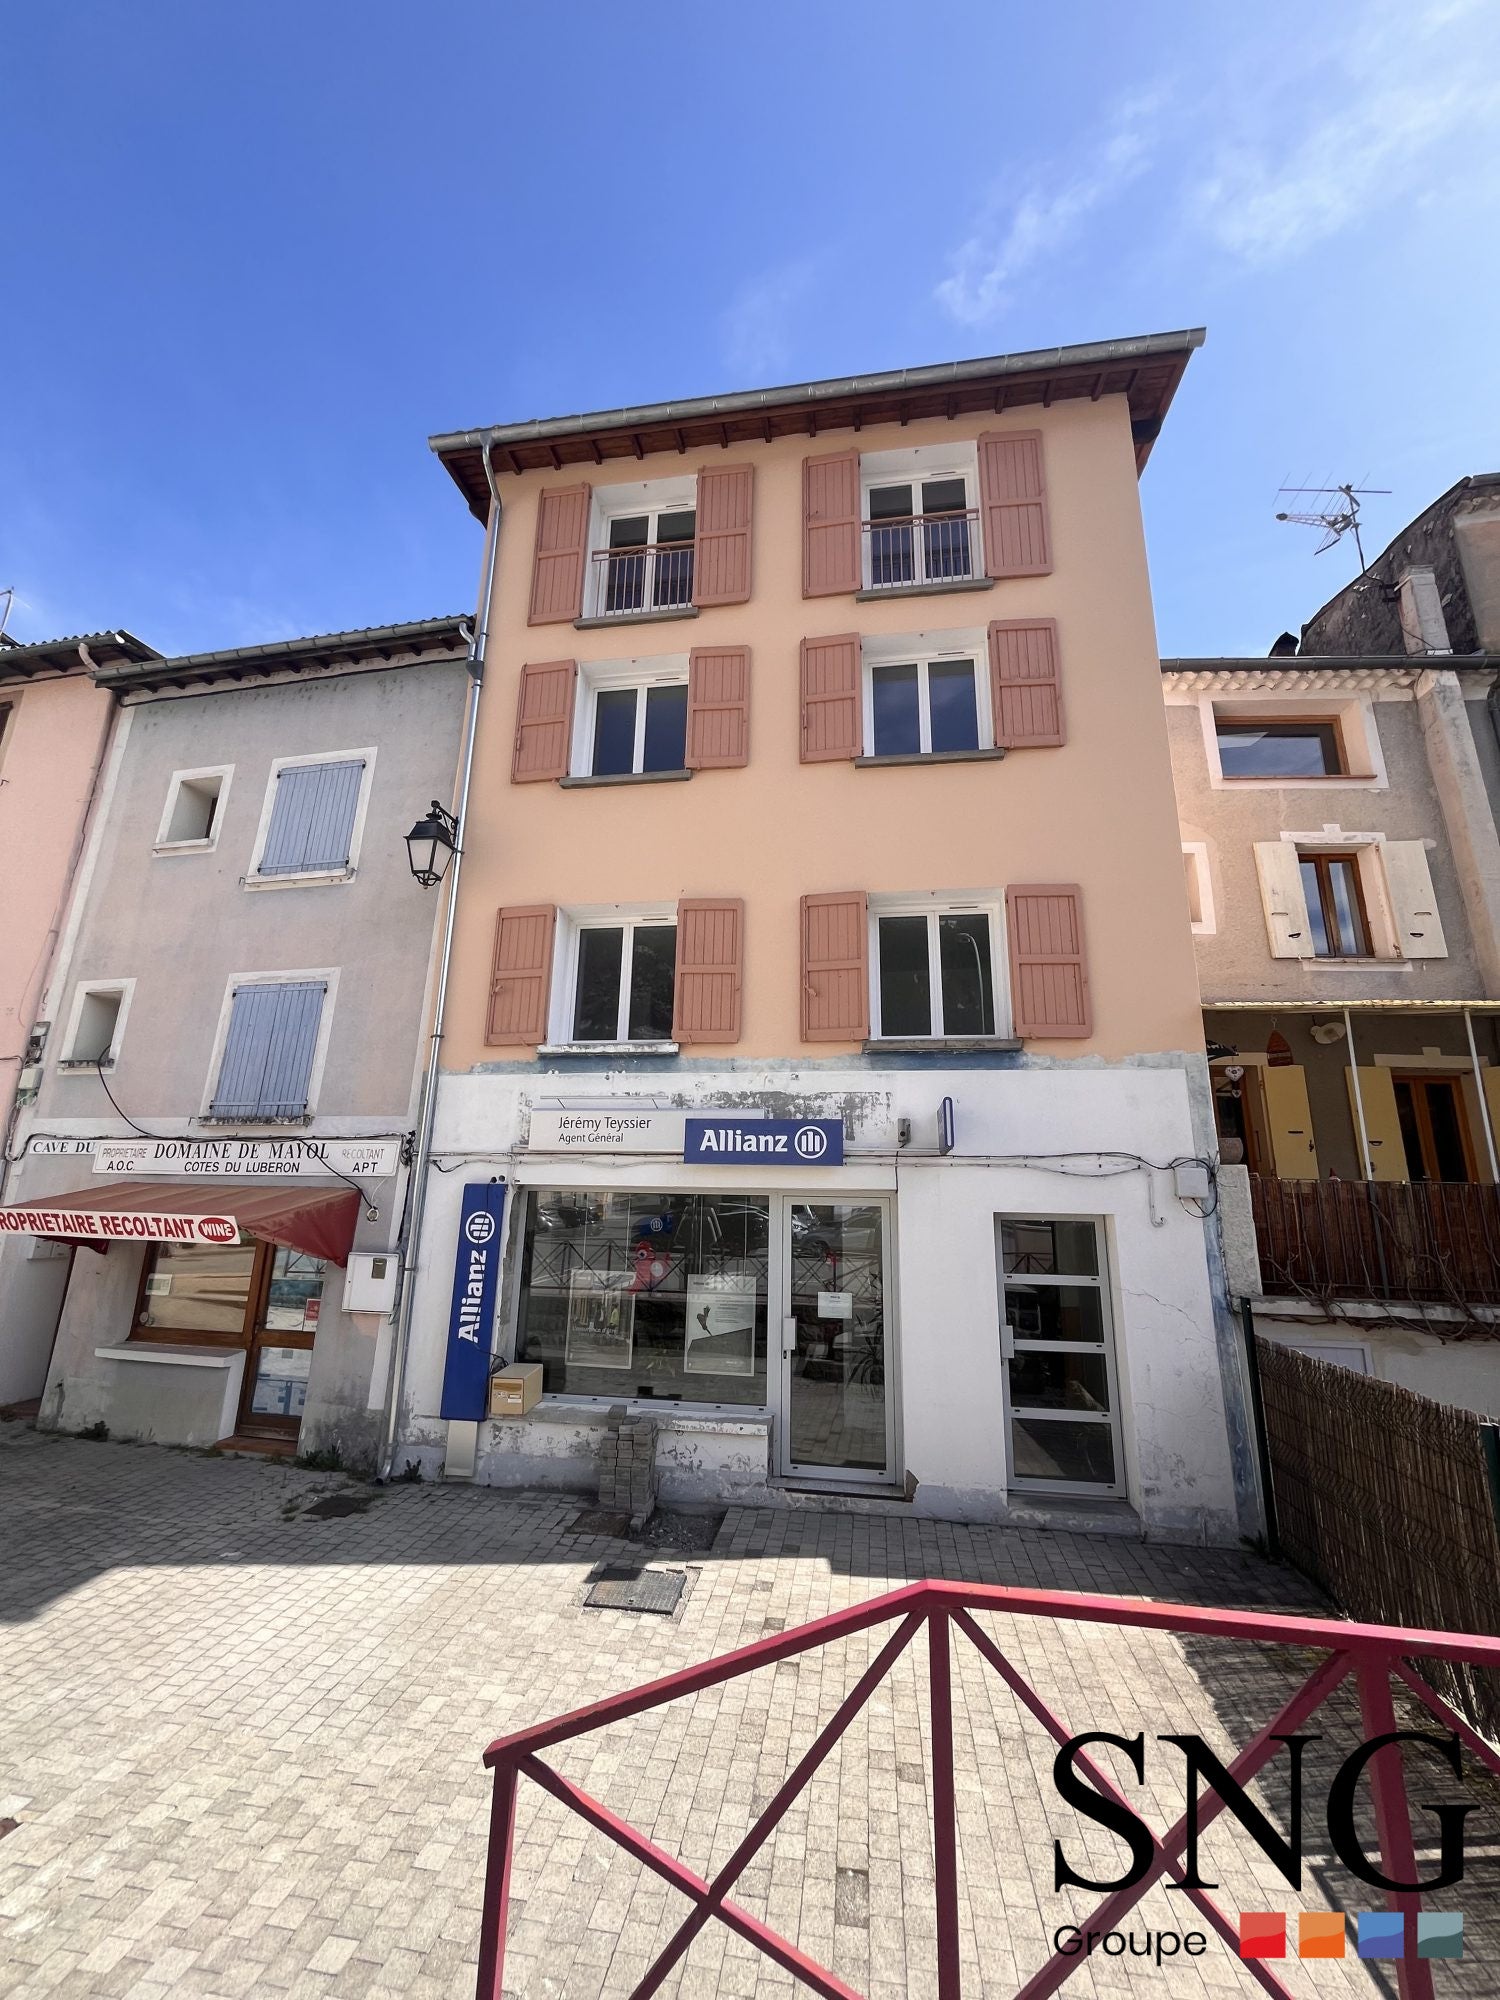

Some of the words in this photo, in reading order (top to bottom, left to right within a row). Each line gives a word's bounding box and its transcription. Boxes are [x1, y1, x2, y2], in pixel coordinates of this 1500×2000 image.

[558, 1116, 602, 1131] Jérémy
[605, 1117, 652, 1131] Teyssier
[558, 1133, 586, 1144] Agent
[588, 1132, 624, 1143] Général
[700, 1129, 788, 1152] Allianz
[33, 1142, 68, 1153] CAVE
[75, 1142, 96, 1153] DU
[154, 1143, 232, 1159] DOMAINE
[238, 1143, 259, 1159] DE
[269, 1143, 330, 1159] MAYOL
[184, 1161, 219, 1172] COTES
[224, 1162, 241, 1172] DU
[245, 1162, 300, 1173] LUBERON
[352, 1162, 378, 1173] APT
[99, 1215, 195, 1239] RECOLTANT
[201, 1223, 233, 1237] WINE
[458, 1250, 487, 1343] Allianz
